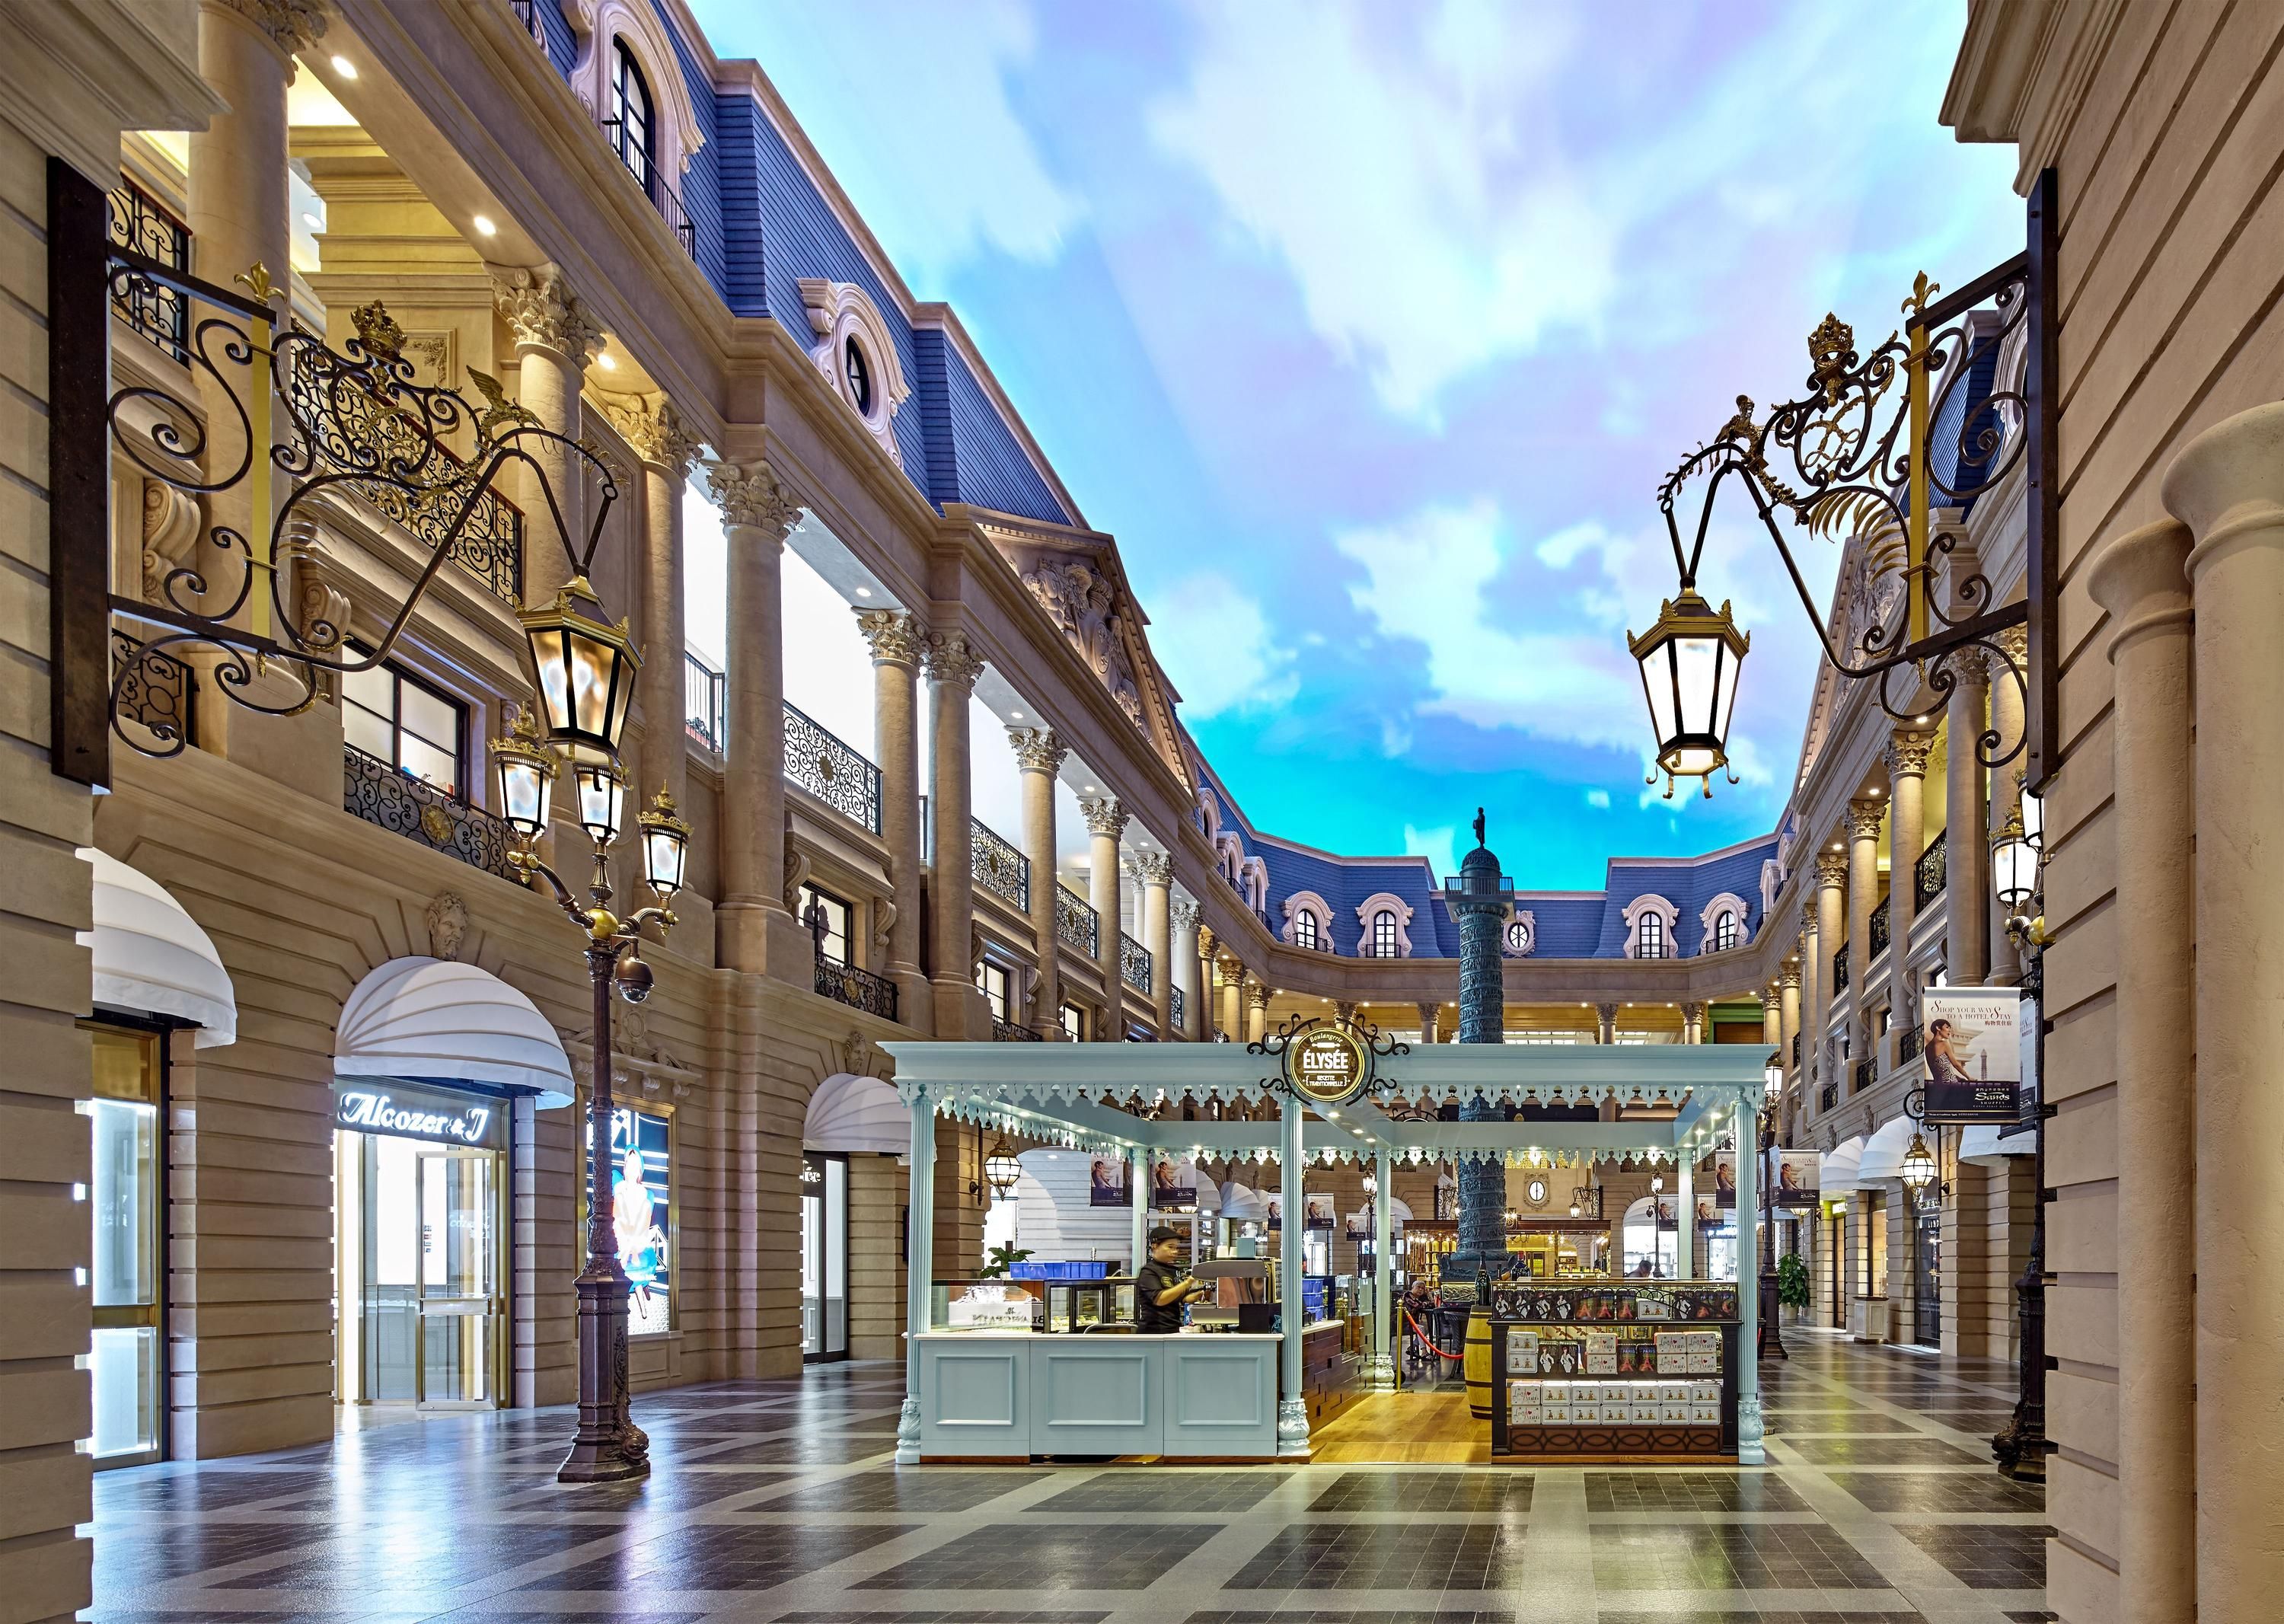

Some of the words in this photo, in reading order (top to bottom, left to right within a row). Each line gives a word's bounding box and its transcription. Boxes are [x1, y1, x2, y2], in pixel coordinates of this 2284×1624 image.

[1931, 1000, 1954, 1013] SHOP
[1990, 1007, 2011, 1019] STAY
[1309, 1033, 1343, 1043] Boulangerie
[1303, 1049, 1348, 1069] ÉLYSÉE
[1974, 1092, 2010, 1101] Sands
[339, 1092, 448, 1134] Alcozer
[448, 1118, 467, 1135] &
[461, 1108, 490, 1141] J
